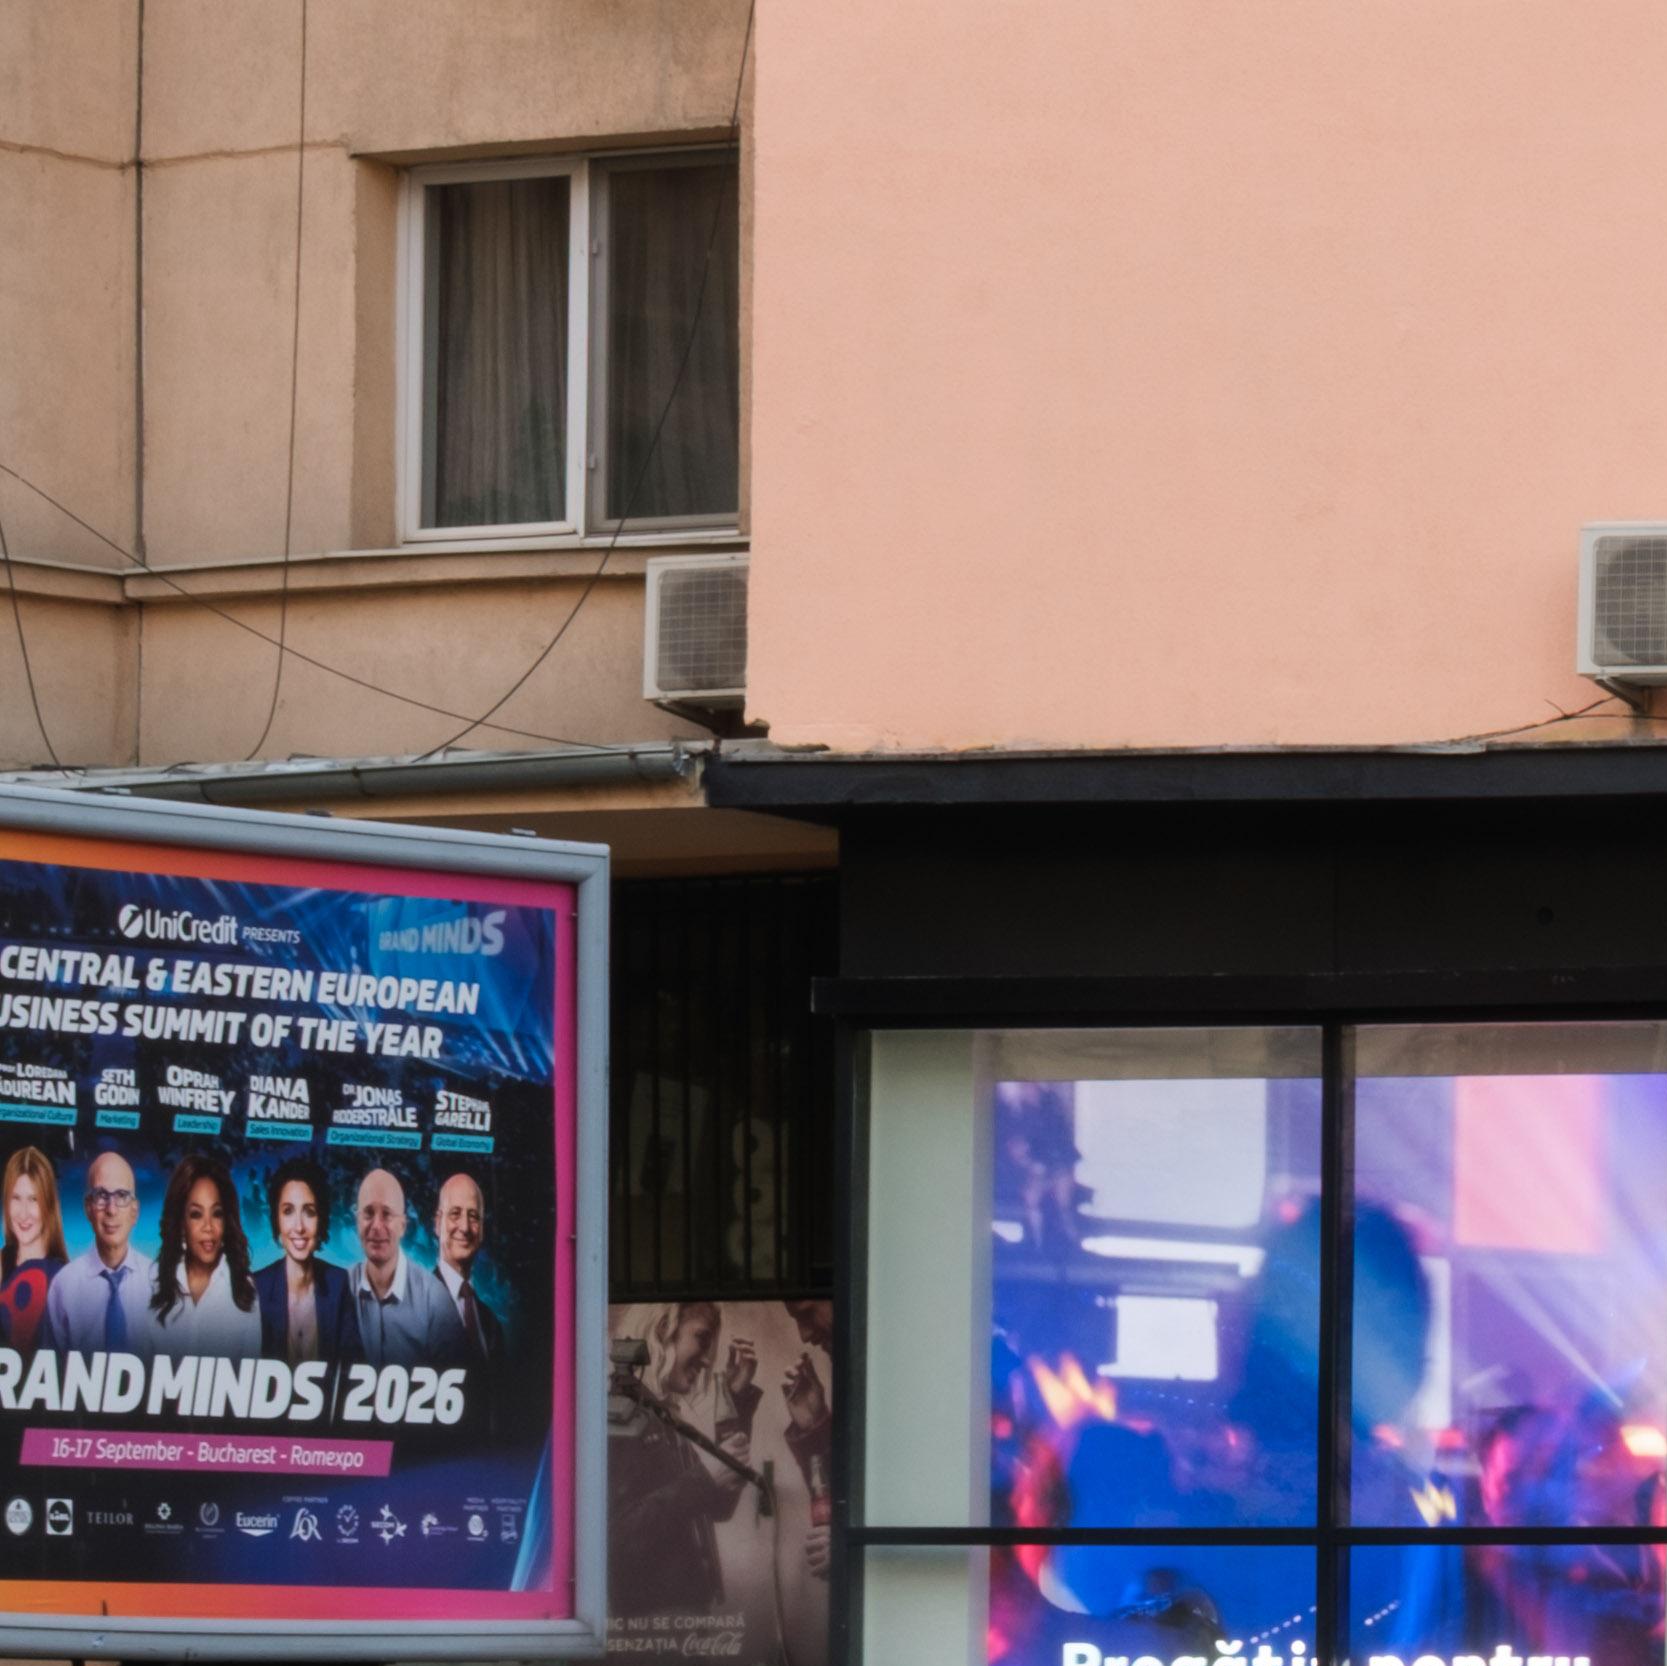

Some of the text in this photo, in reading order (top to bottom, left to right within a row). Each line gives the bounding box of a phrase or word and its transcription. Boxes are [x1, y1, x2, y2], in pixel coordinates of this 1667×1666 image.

[146, 908, 300, 945] UniCredit PRESENTS
[422, 910, 507, 956] MINDS
[0, 945, 480, 1015] CENTRAL & EASTERN EUROPEAN
[122, 1004, 247, 1045] SUMMIT
[250, 1013, 292, 1048] OF
[297, 1017, 357, 1053] THE
[364, 1023, 444, 1059] YEAR
[102, 1068, 135, 1087] SETH
[167, 1065, 219, 1089] OPRAH
[250, 1075, 309, 1103] DIANA
[0, 1079, 76, 1106] DUREAN
[95, 1083, 140, 1106] GODIN
[158, 1086, 236, 1115] WINFREY
[352, 1085, 403, 1107] JONAS
[248, 1094, 310, 1120] KANDER
[435, 1111, 491, 1132] GARELLI
[0, 1348, 146, 1414] RAND
[342, 1363, 466, 1425] 2026
[52, 1437, 91, 1458] 16-17
[96, 1439, 183, 1463] September
[197, 1441, 276, 1465] Bucharest
[291, 1445, 364, 1468] Romexpo
[87, 1511, 134, 1526] TEILOR
[236, 1511, 277, 1528] Eucerin
[627, 1617, 649, 1631] NU
[652, 1616, 670, 1630] SE
[674, 1612, 746, 1629] COMPARĂ
